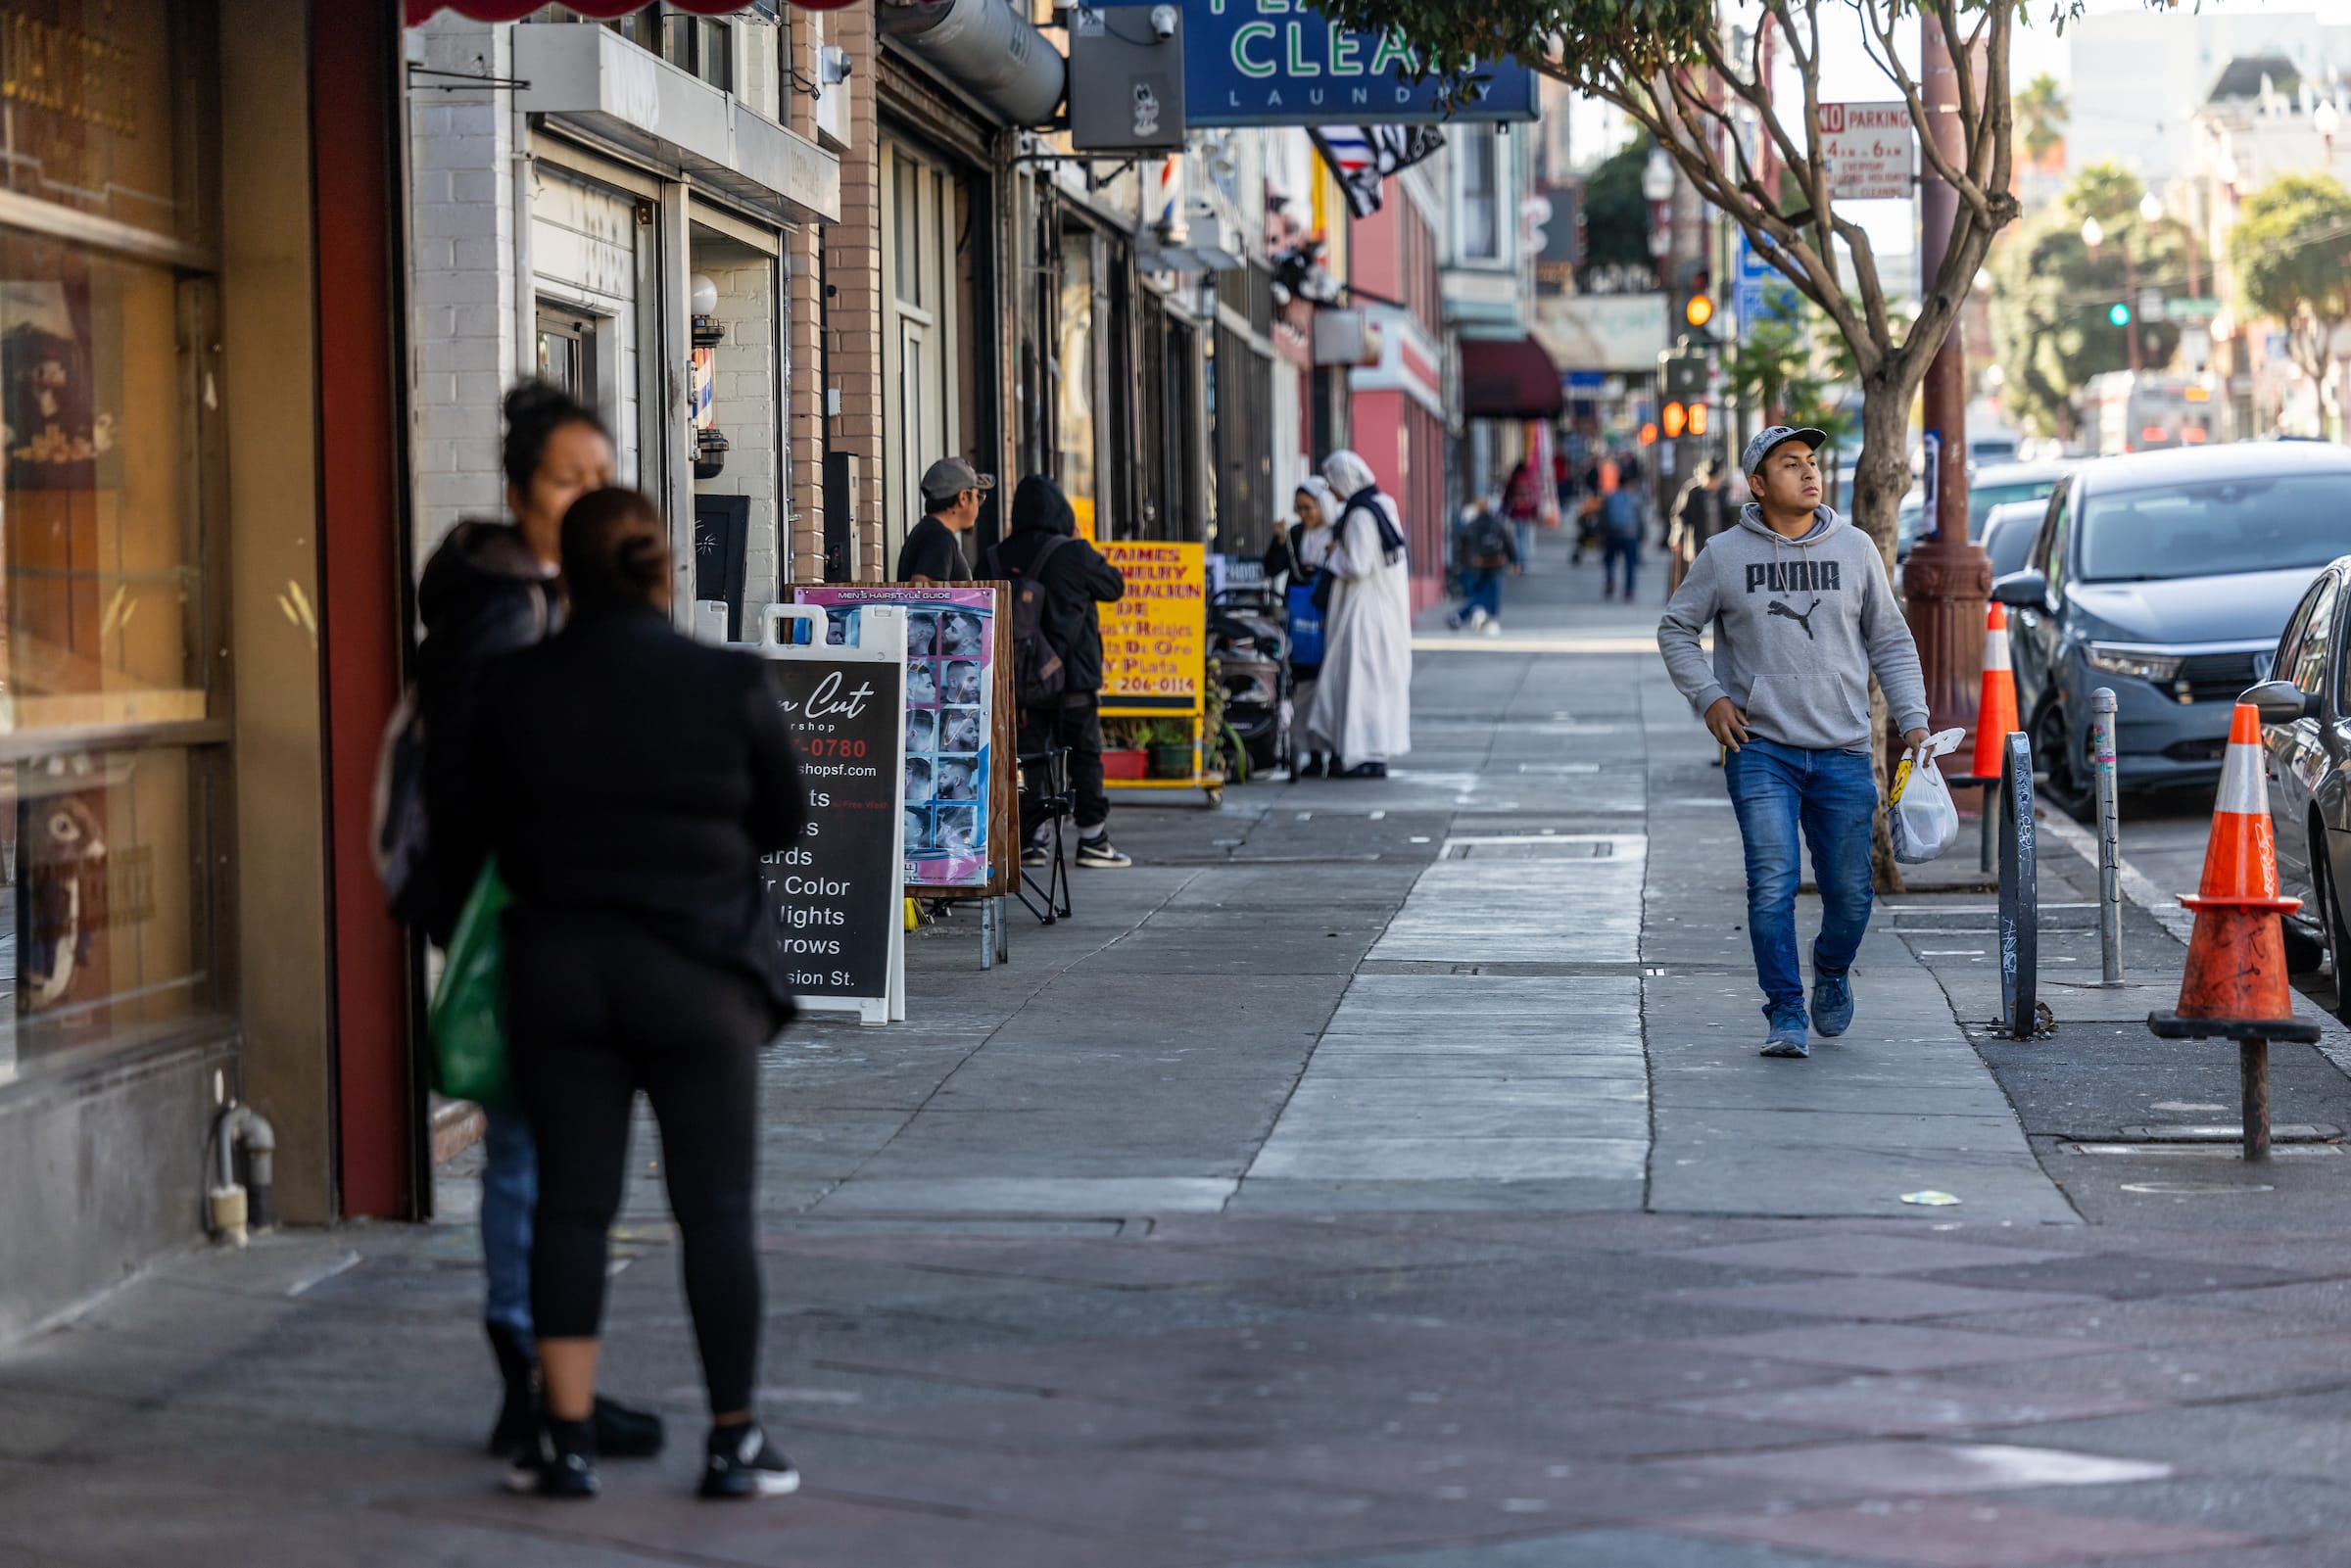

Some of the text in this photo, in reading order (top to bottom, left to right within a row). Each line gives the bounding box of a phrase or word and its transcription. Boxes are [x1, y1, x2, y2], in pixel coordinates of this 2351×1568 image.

[1820, 104, 1909, 130] NO PARKING
[1746, 560, 1842, 594] PUMA
[838, 592, 952, 600] MEN'S HAIRSTYLE GUIDE
[1123, 583, 1201, 600] RACION
[804, 671, 875, 719] Cut
[785, 876, 850, 896] Color
[776, 938, 840, 955] rows
[831, 970, 855, 986] St.
